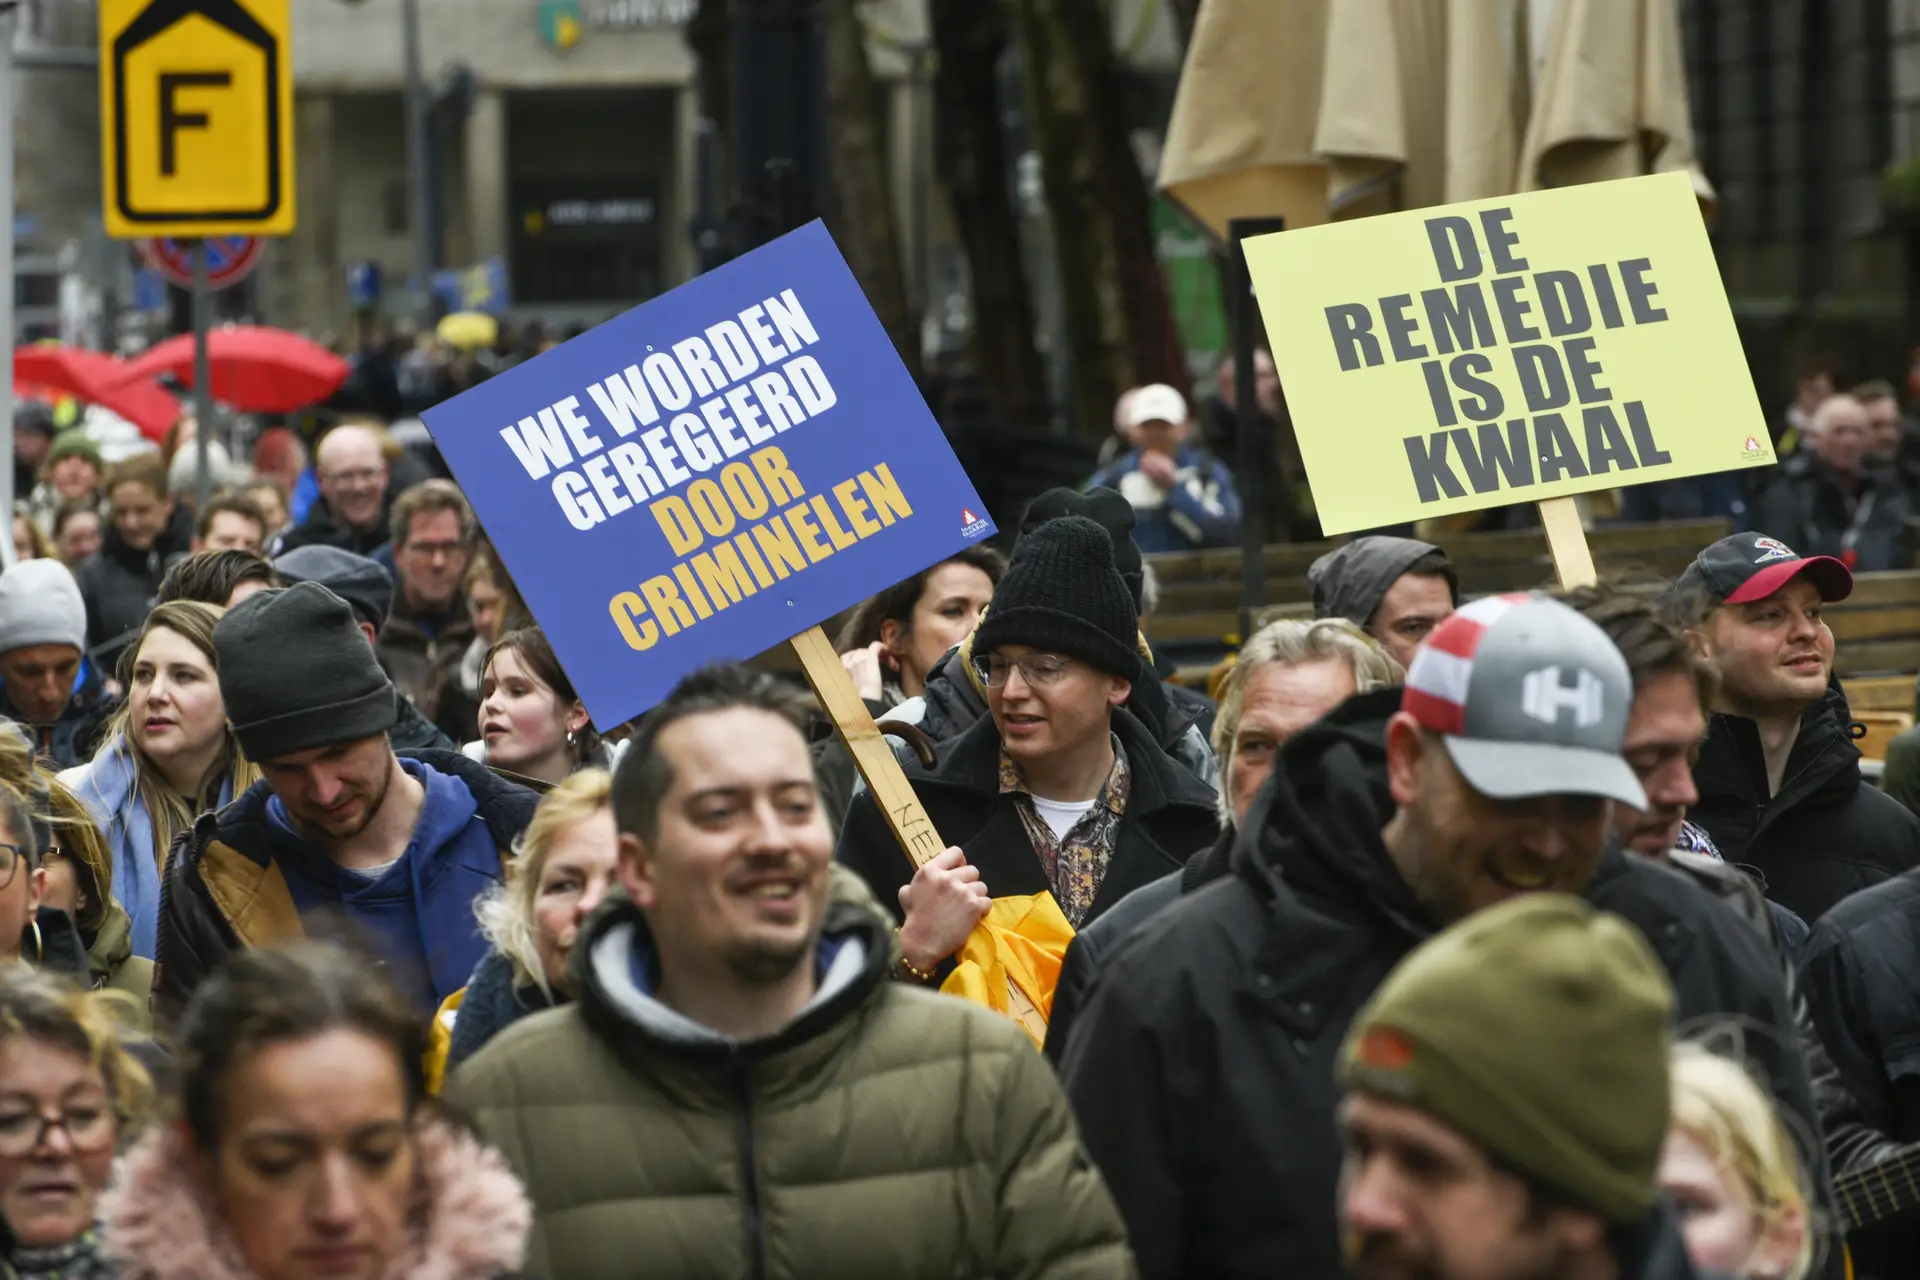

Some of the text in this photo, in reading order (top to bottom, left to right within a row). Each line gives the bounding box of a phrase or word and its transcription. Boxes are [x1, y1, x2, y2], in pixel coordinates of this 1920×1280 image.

[159, 71, 232, 176] F
[1424, 207, 1530, 283] DE
[1324, 257, 1669, 372] REMEDIE
[500, 288, 820, 481] WE WORDEN
[1421, 336, 1613, 428] IS DE
[551, 355, 837, 531] GEREGEERD
[1403, 400, 1672, 504] KWAAL
[609, 462, 914, 651] CRIMINELEN
[649, 446, 805, 557] DOOR
